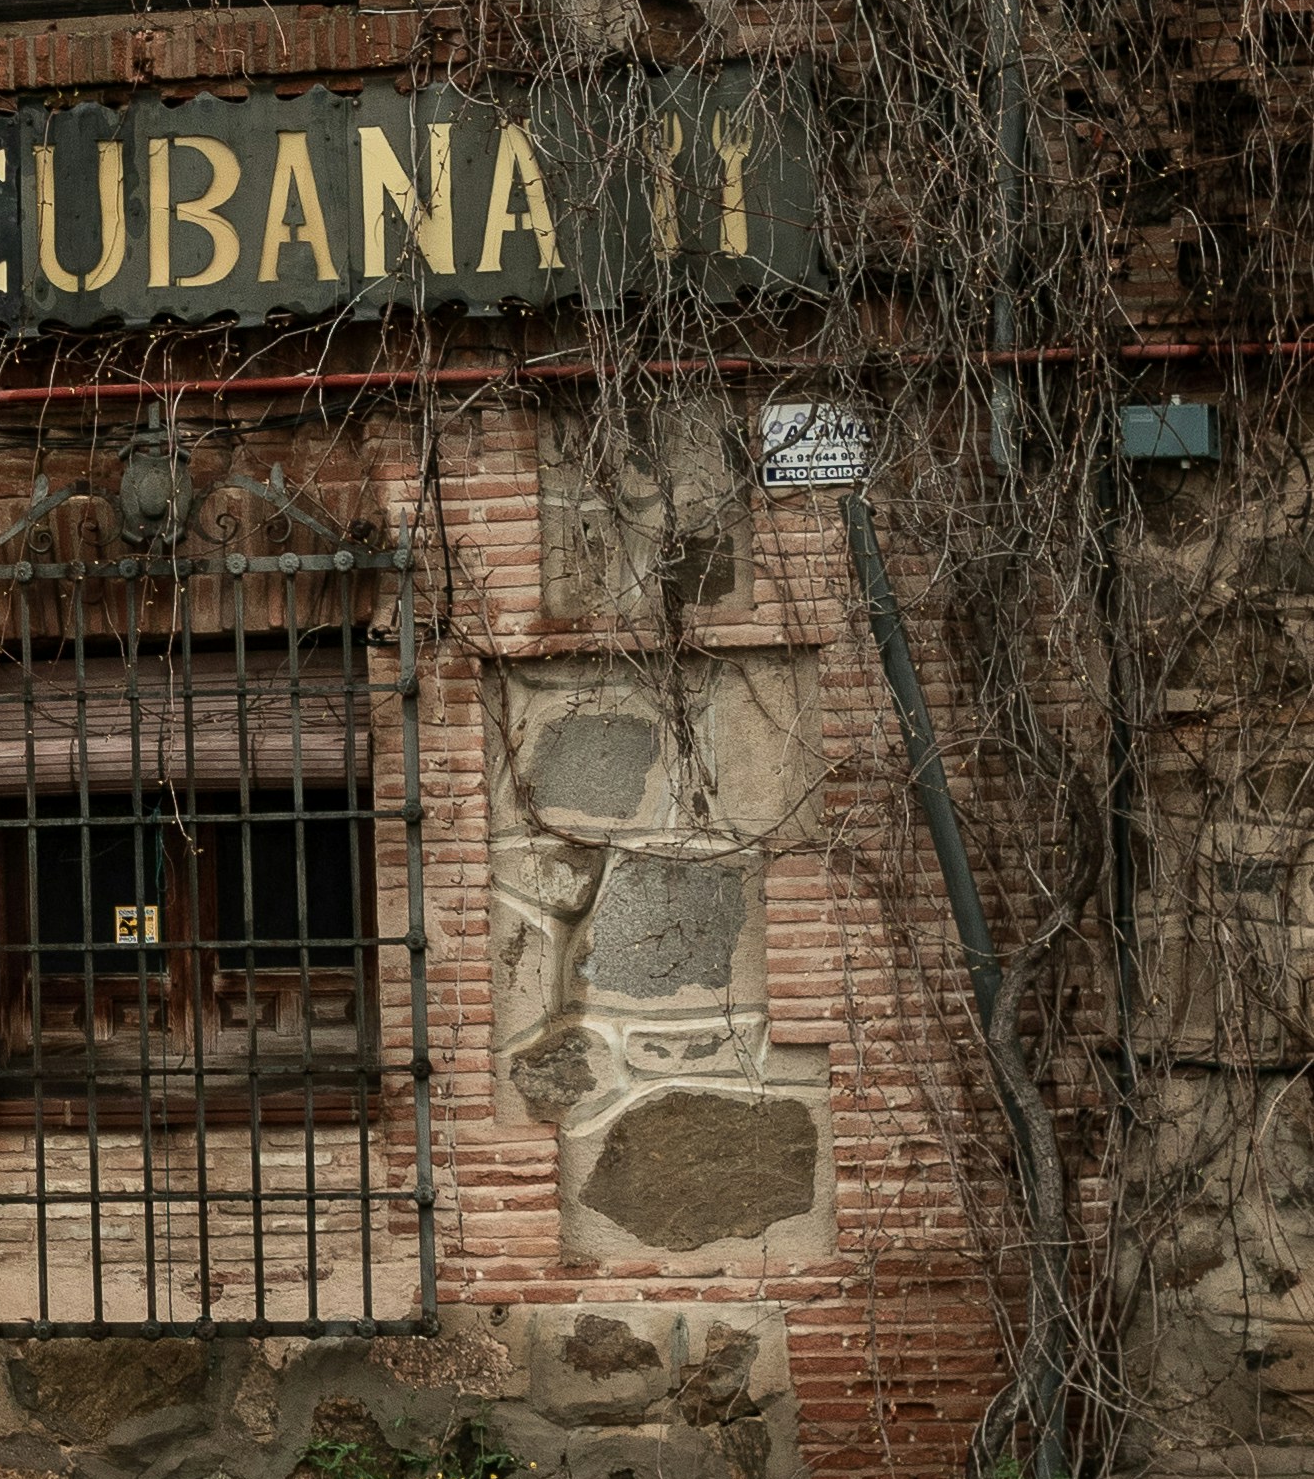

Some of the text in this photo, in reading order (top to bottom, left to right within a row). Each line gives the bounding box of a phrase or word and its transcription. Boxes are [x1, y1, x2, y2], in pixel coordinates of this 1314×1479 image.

[815, 453, 837, 462] 644
[841, 452, 855, 461] 90
[775, 467, 864, 480] PROTEGIDO
